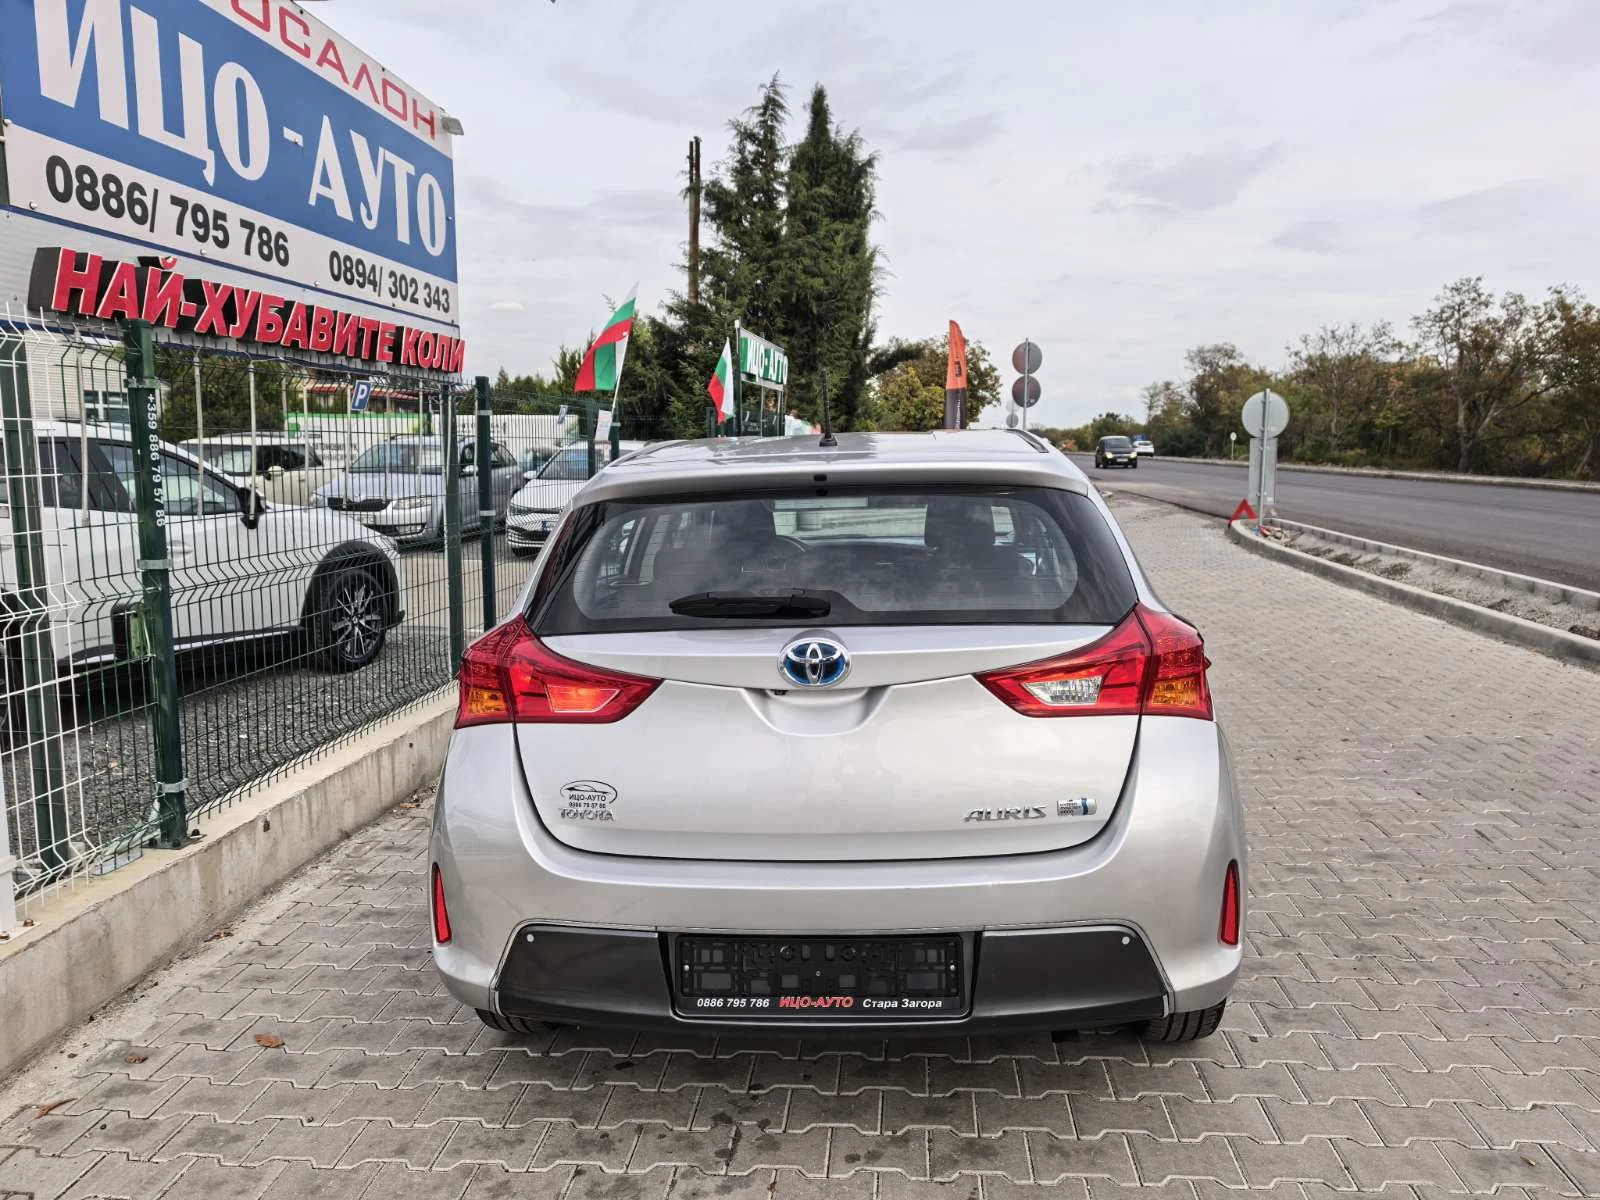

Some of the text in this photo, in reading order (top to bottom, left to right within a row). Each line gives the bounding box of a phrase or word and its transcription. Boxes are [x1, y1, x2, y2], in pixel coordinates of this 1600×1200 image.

[46, 156, 290, 267] 0886/ 795 786
[329, 250, 450, 313] 0894/ 302 343
[51, 247, 465, 373] НАЙ-ХУБАВИТЕ КОЛИ
[355, 384, 368, 407] P
[147, 393, 167, 527] +359 886 79 57 86
[569, 794, 607, 802] ИЦО-АУТО
[559, 808, 615, 821] TOYOTA
[964, 806, 1047, 822] AURIS
[697, 996, 943, 1009] 0886 795 786 ИЦО-АУТО Стара Загора
